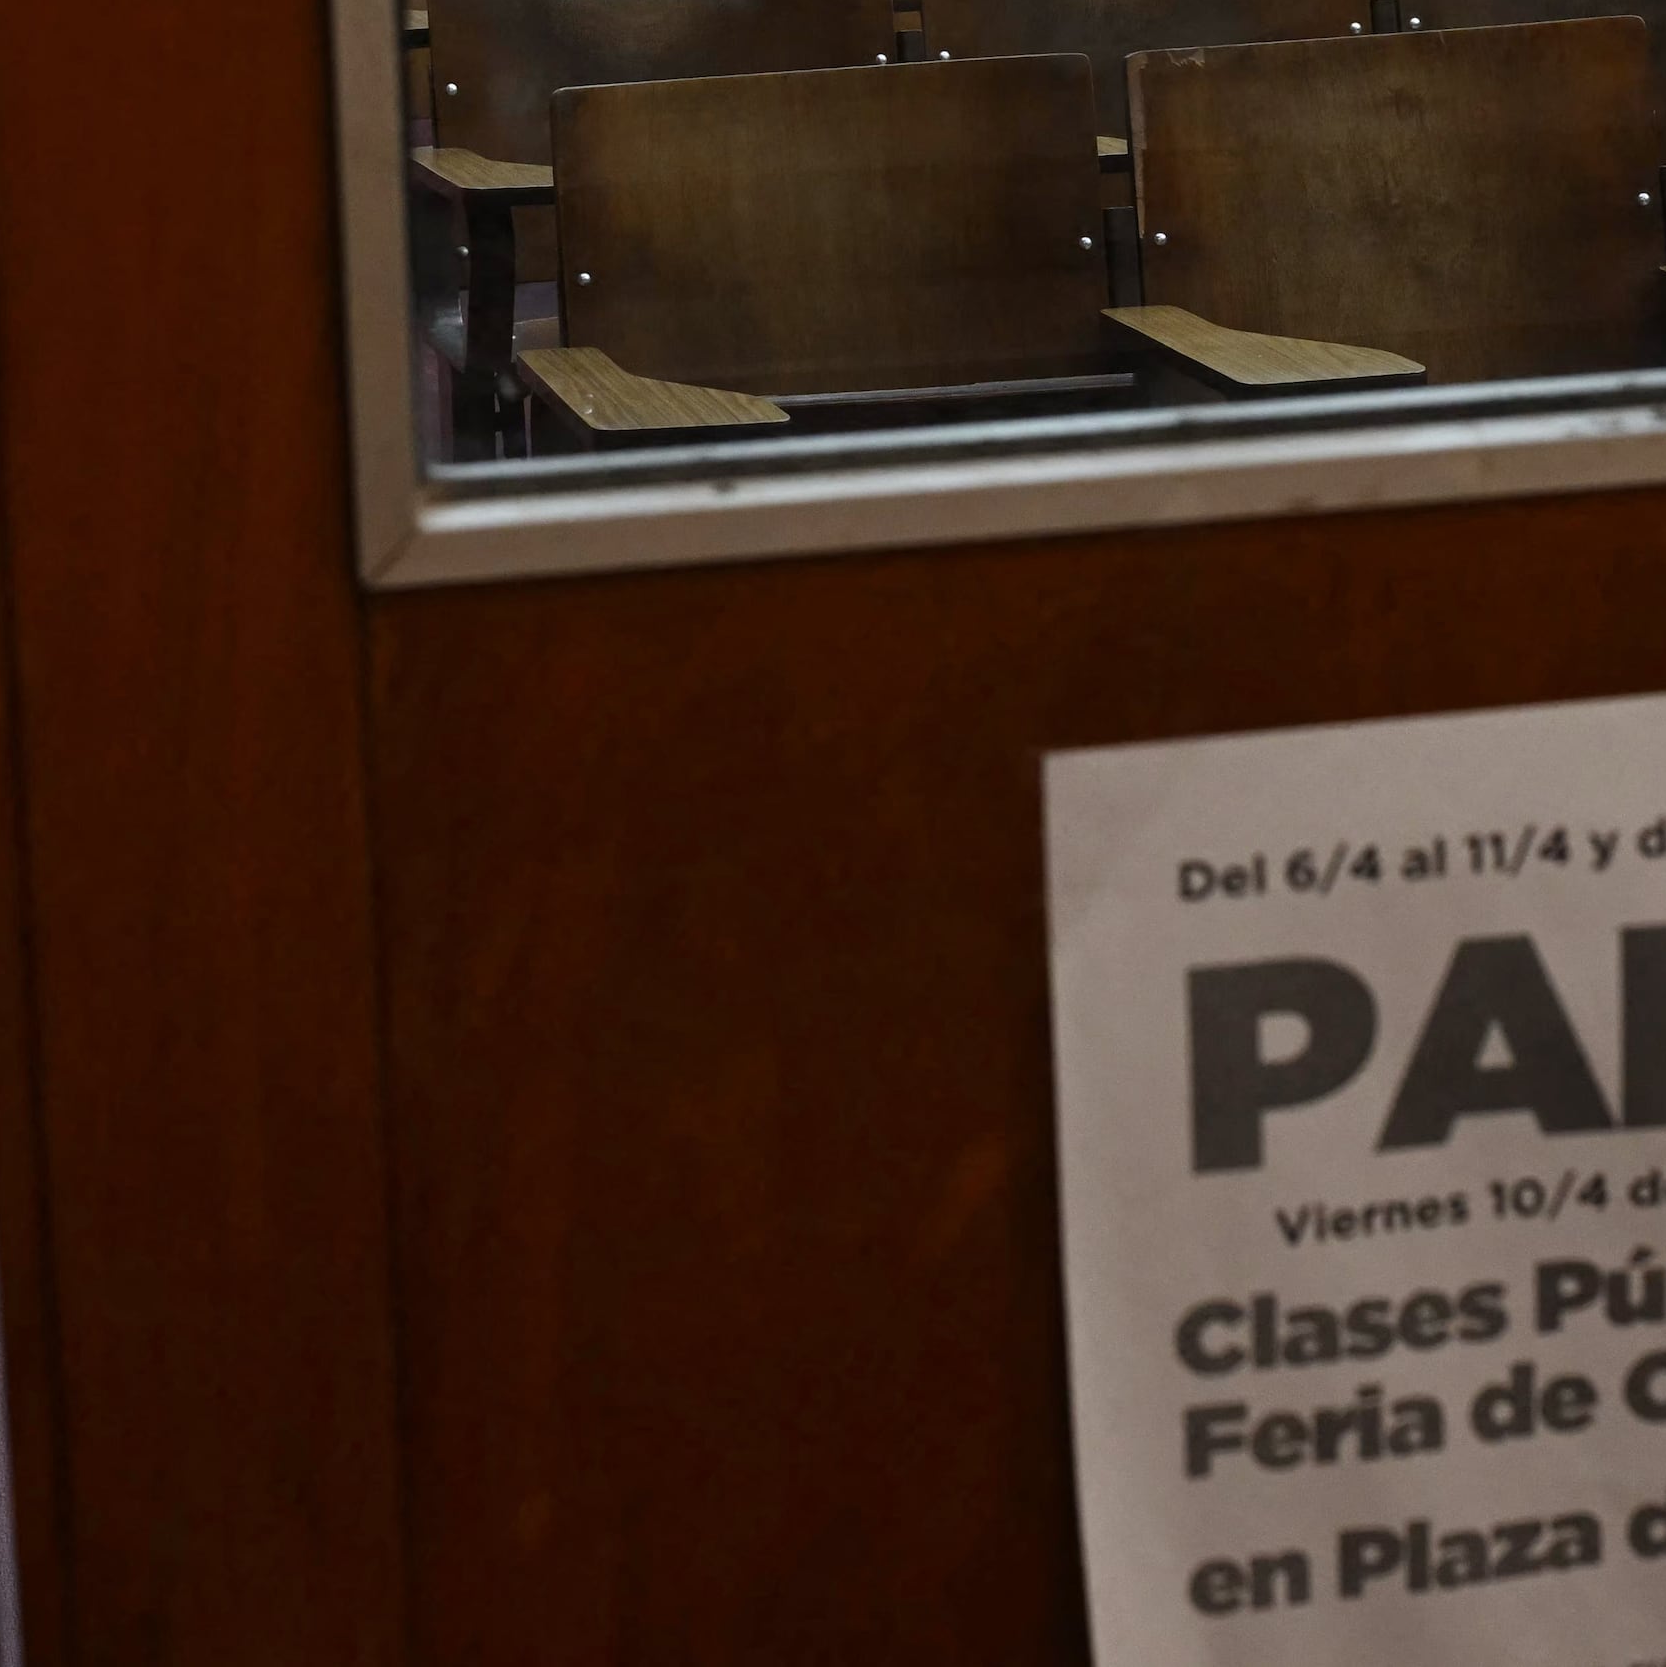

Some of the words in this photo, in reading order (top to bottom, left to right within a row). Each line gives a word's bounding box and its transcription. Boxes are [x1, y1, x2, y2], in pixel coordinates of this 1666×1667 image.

[1176, 851, 1268, 904] Del
[1283, 841, 1383, 897] 6/4
[1399, 835, 1448, 883] al
[1466, 824, 1571, 878] 11/4
[1588, 830, 1619, 874] y
[1274, 1190, 1471, 1248] Viernes
[1488, 1169, 1610, 1222] 10/4
[1175, 1278, 1511, 1378] Clases
[1182, 1383, 1446, 1479] Feria
[1469, 1360, 1600, 1443] de
[1187, 1547, 1313, 1617] en
[1337, 1508, 1603, 1600] Plaza
